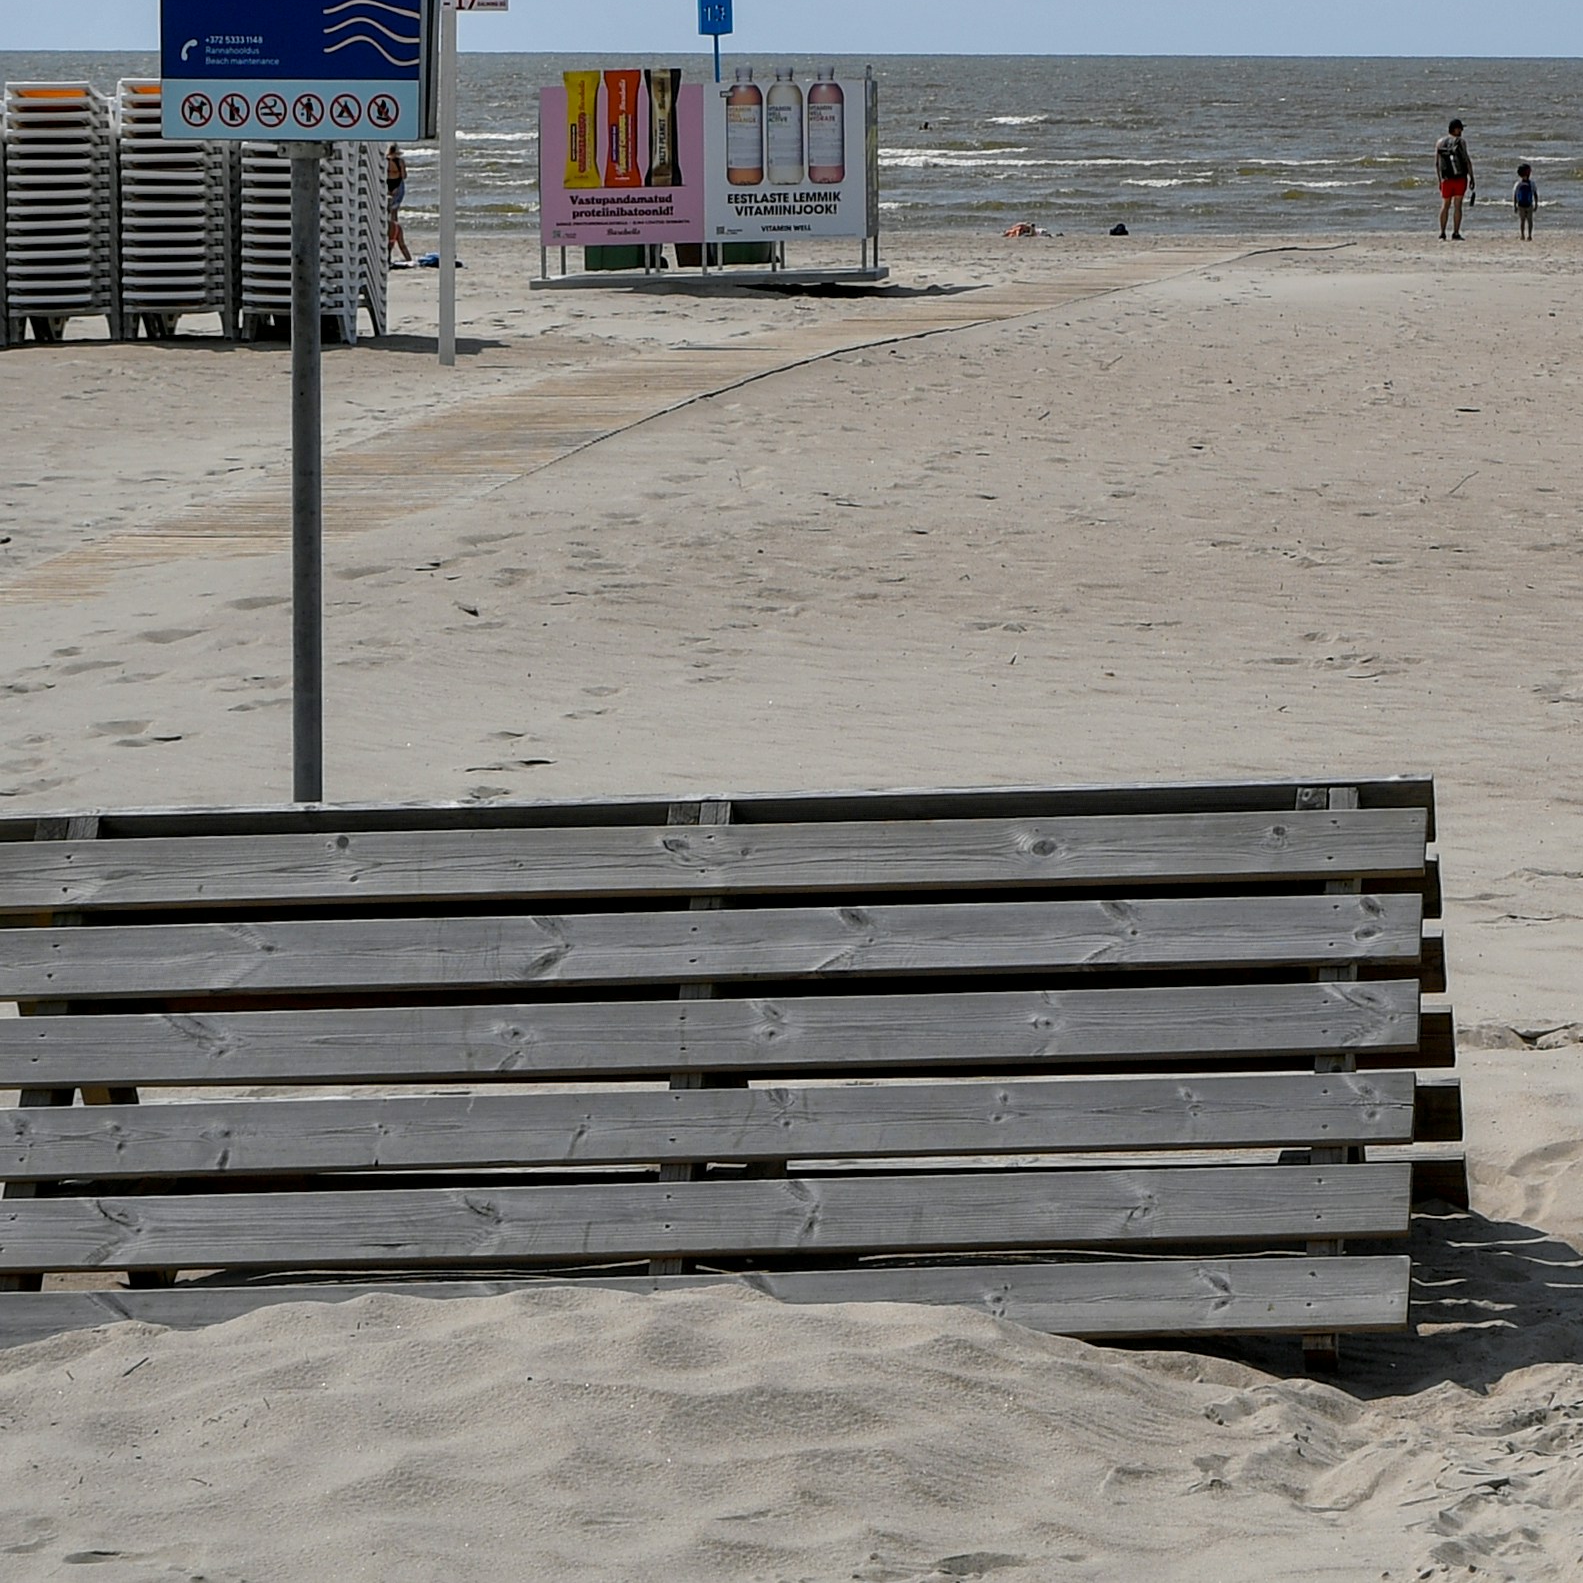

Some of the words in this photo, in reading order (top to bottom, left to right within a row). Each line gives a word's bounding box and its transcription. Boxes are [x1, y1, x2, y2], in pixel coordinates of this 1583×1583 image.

[205, 35, 224, 45] +372
[205, 45, 260, 55] Rannahooldus
[205, 56, 229, 66] Beach
[230, 56, 280, 66] maintenance
[569, 194, 673, 206] Vastupandamatud
[727, 192, 790, 205] EESTLASTE
[793, 191, 842, 203] LEMMIK
[572, 205, 675, 220] proteiinibatoonid!
[735, 203, 838, 217] VITAMIINIJOOK!
[761, 224, 793, 233] VITAMIN
[793, 224, 812, 232] WELL
